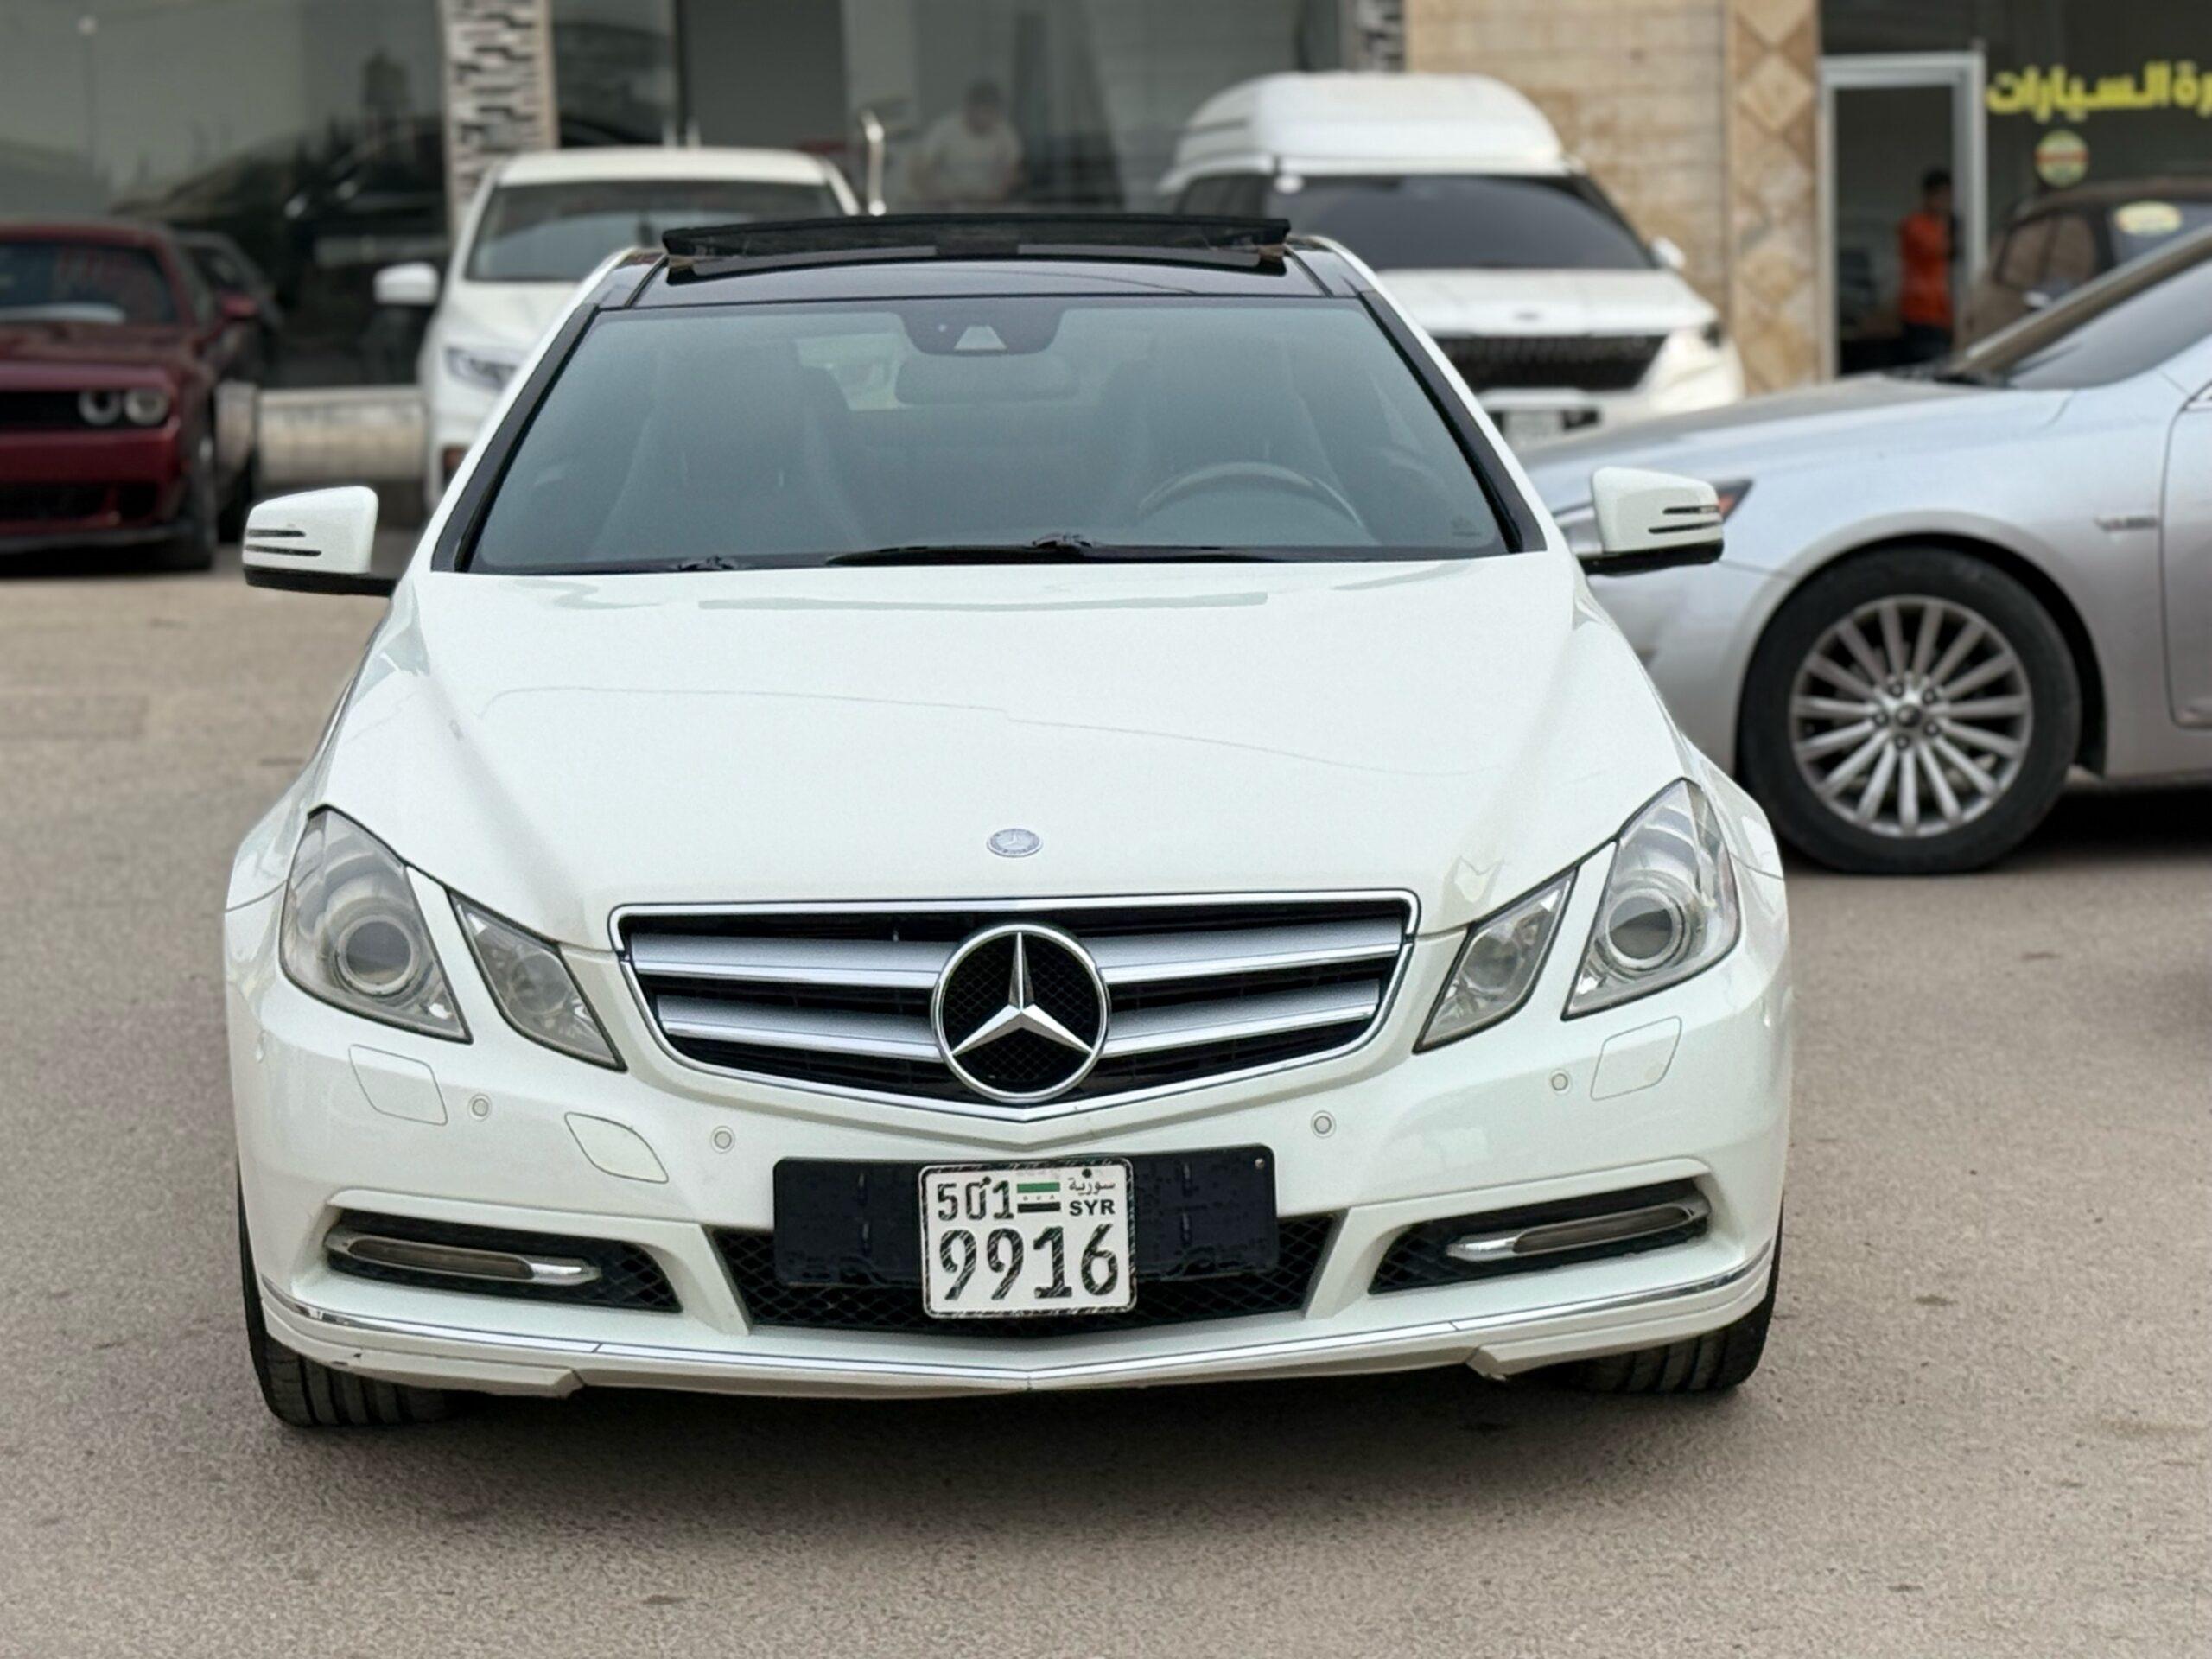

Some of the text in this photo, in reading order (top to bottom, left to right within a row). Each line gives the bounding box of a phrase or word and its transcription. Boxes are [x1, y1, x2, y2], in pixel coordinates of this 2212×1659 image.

[1986, 60, 2171, 122] السيارات
[938, 1180, 1014, 1220] 501
[1068, 1177, 1116, 1196] سورية
[1069, 1199, 1116, 1217] SYR
[939, 1224, 1118, 1300] 9916
